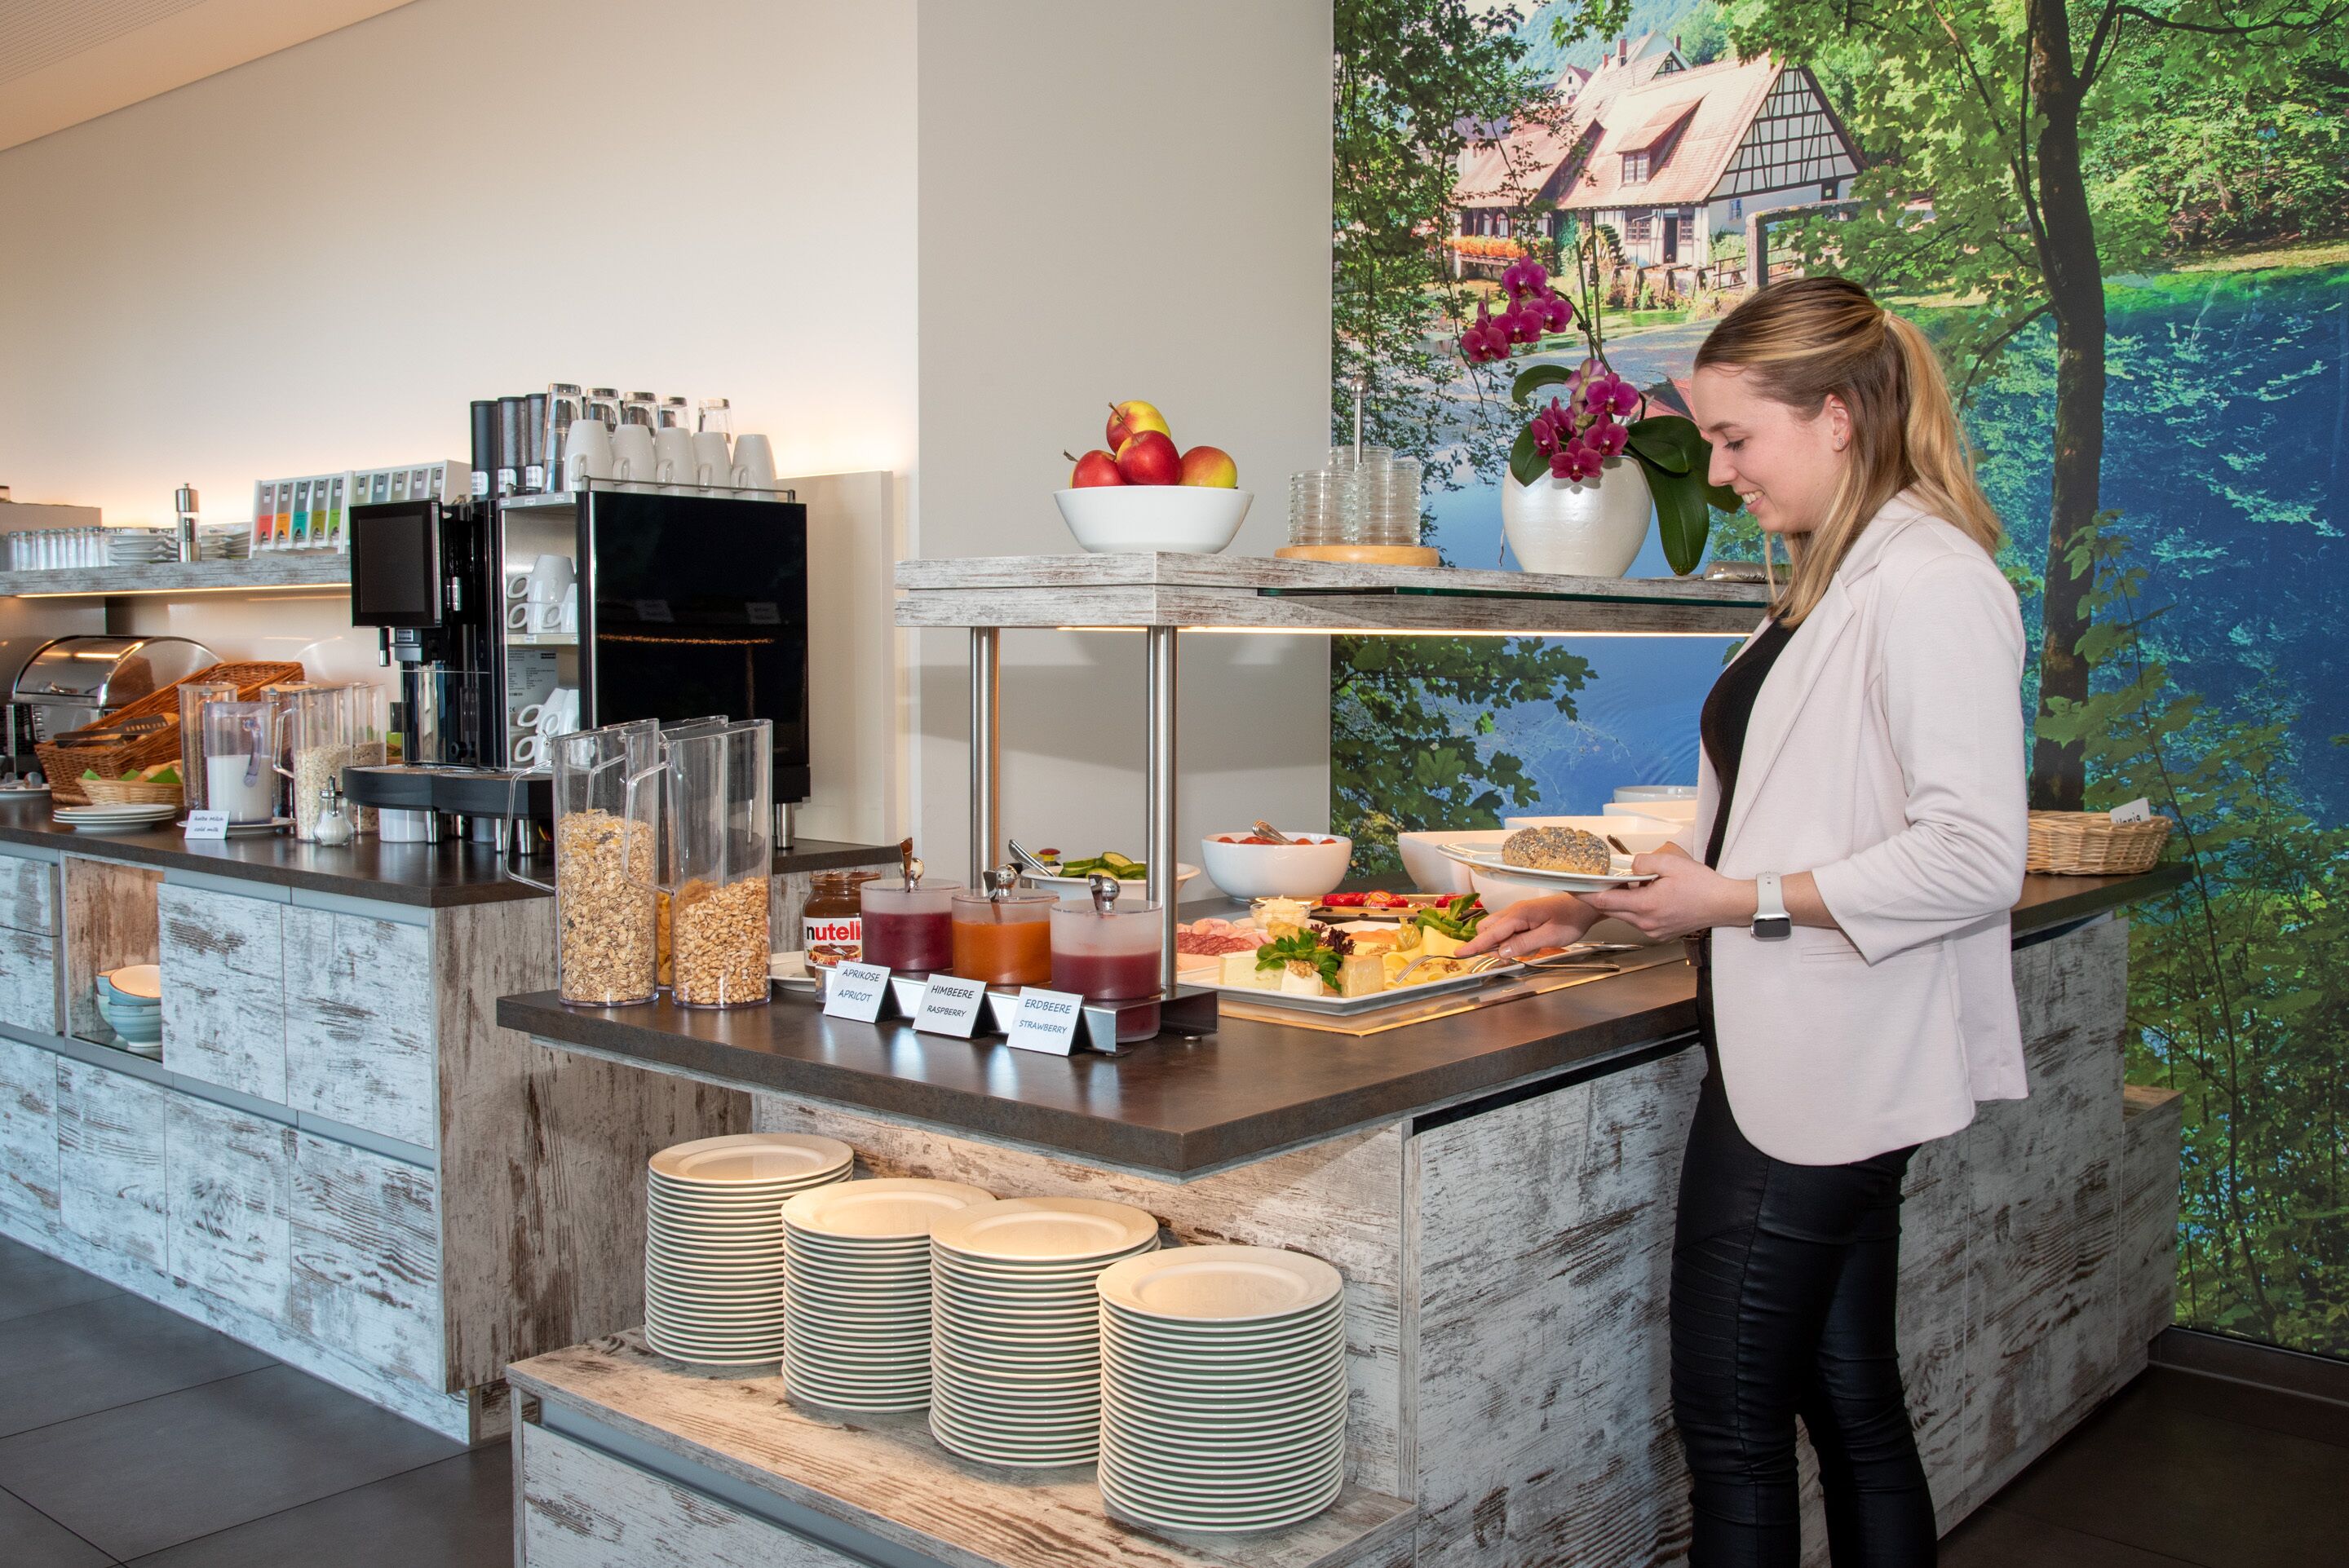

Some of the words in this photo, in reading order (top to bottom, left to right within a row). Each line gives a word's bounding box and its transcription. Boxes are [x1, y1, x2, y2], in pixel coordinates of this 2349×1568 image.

[806, 921, 861, 941] nutell
[842, 968, 881, 983] APRIKOSE
[838, 988, 873, 1002] APRICOT
[931, 984, 975, 999] HIMBEERE
[927, 1005, 967, 1018] RASPBERRY
[1024, 998, 1073, 1014] ERDBEERE
[1019, 1019, 1068, 1035] STRAWBERRY
